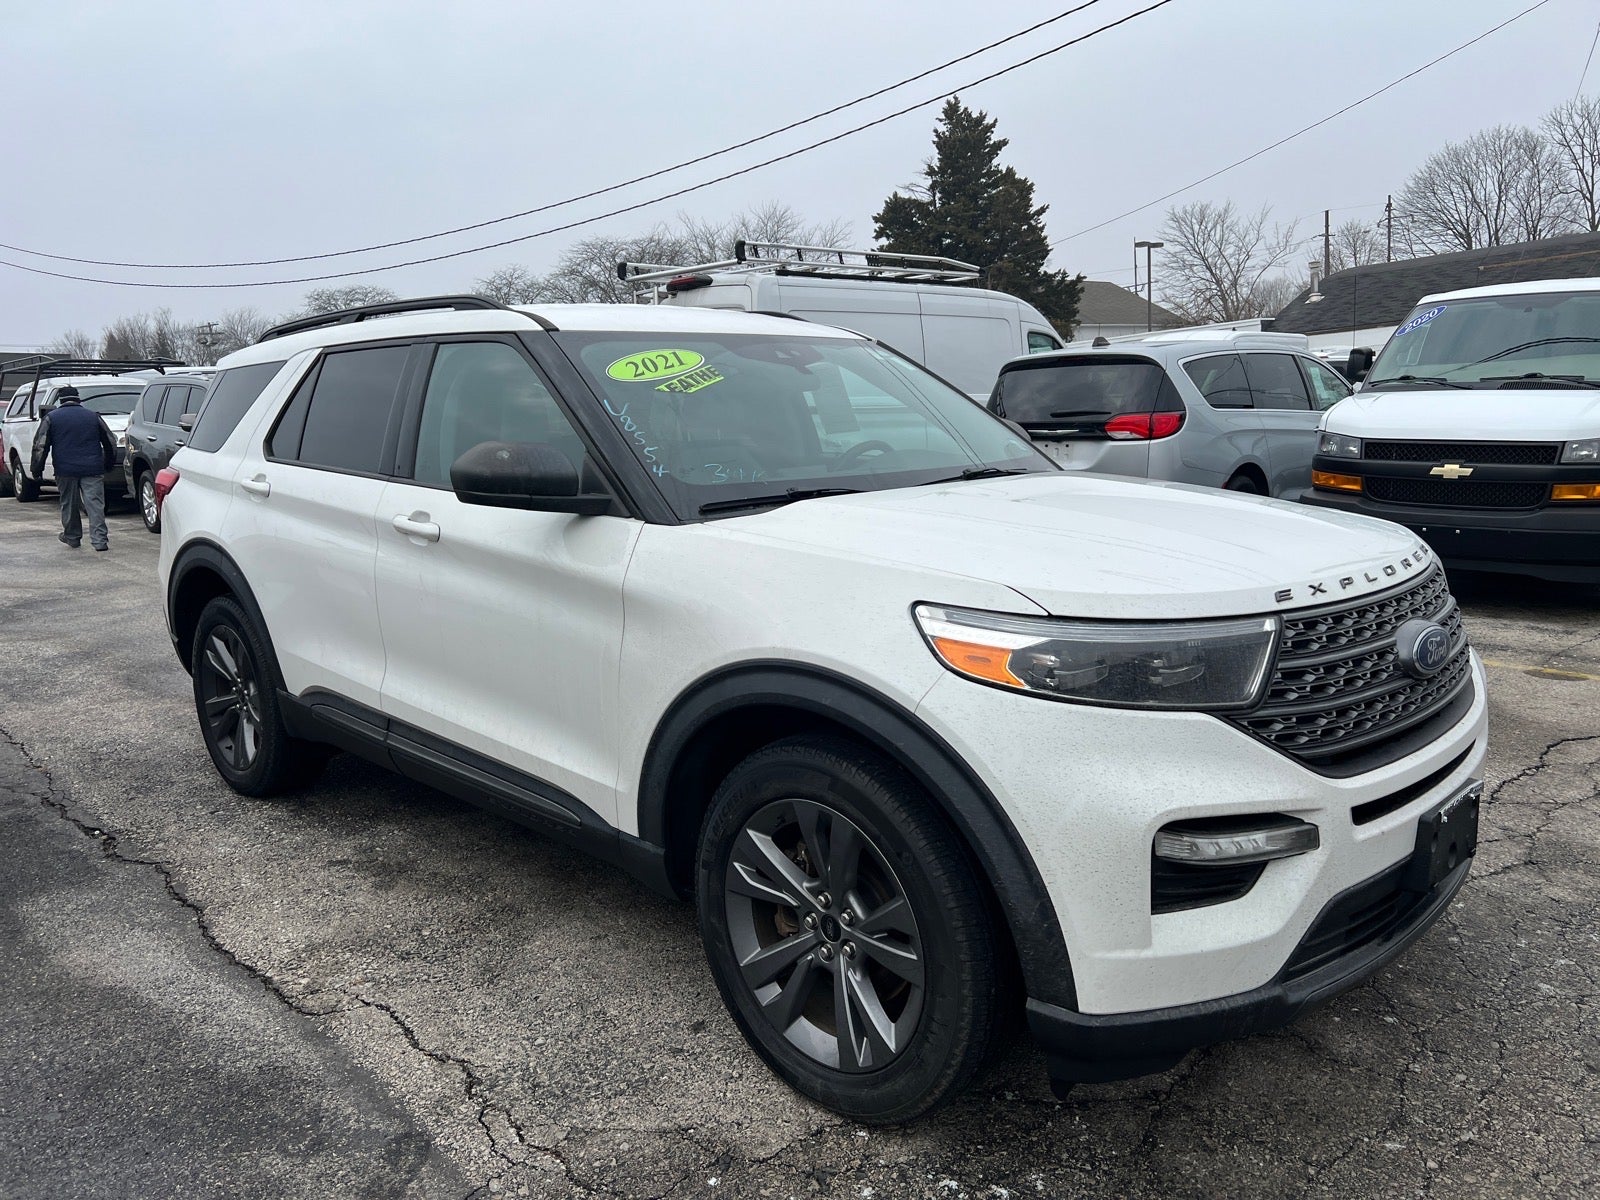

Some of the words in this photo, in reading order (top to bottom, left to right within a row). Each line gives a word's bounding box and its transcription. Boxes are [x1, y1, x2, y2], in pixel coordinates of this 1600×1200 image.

[1404, 309, 1438, 333] 2020
[625, 351, 687, 378] 2021
[1274, 543, 1429, 603] EXPLORER
[1427, 636, 1447, 664] Ford
